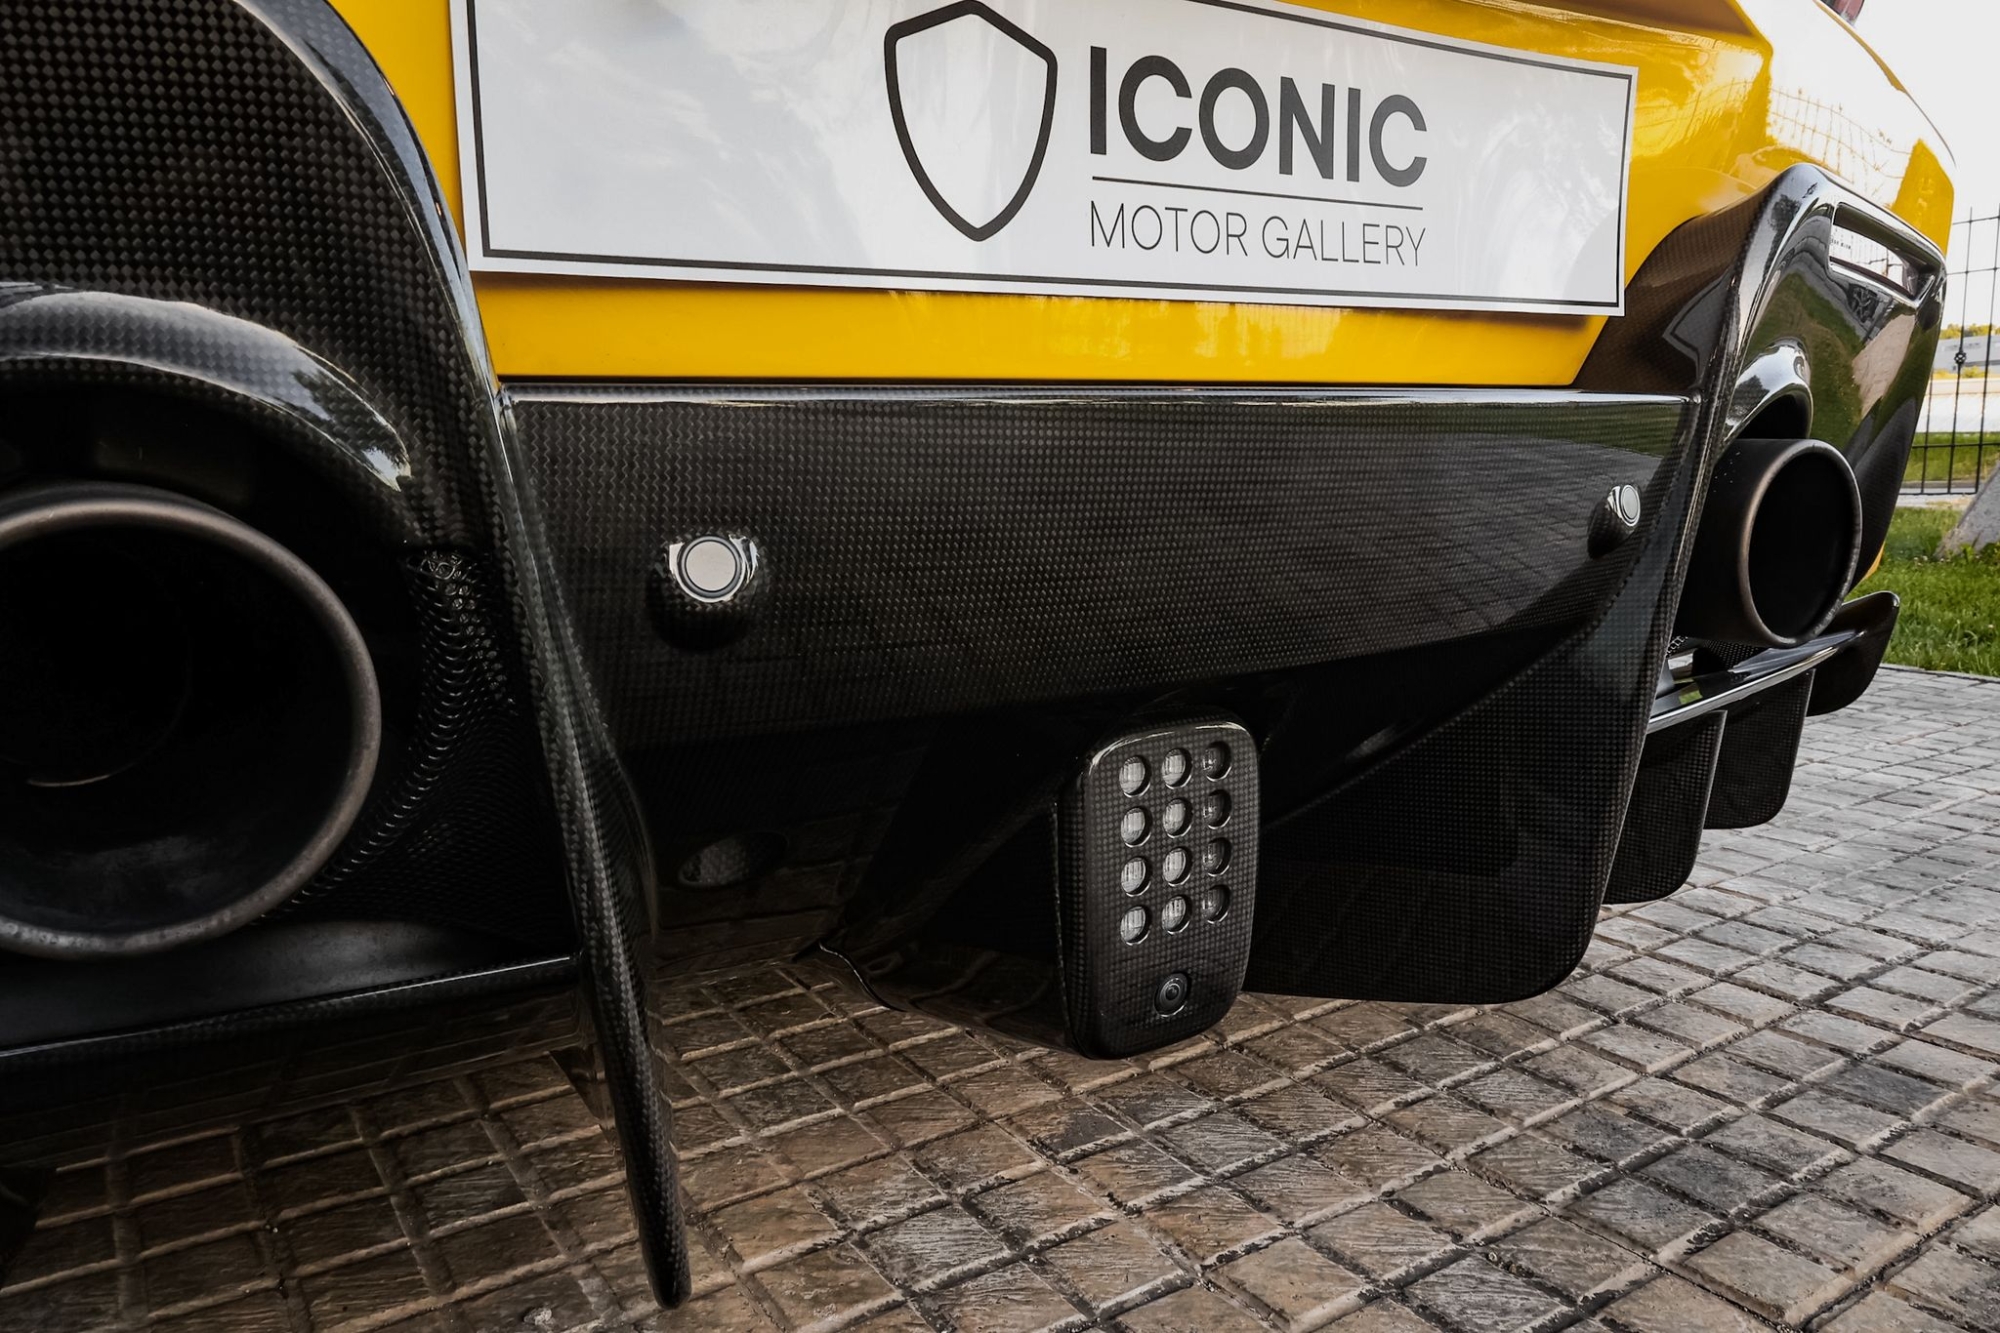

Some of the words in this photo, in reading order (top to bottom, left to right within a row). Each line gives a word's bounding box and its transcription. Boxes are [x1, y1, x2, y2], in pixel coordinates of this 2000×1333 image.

[1090, 45, 1427, 187] ICONIC
[1091, 200, 1248, 256] MOTOR
[1262, 215, 1426, 266] GALLERY
